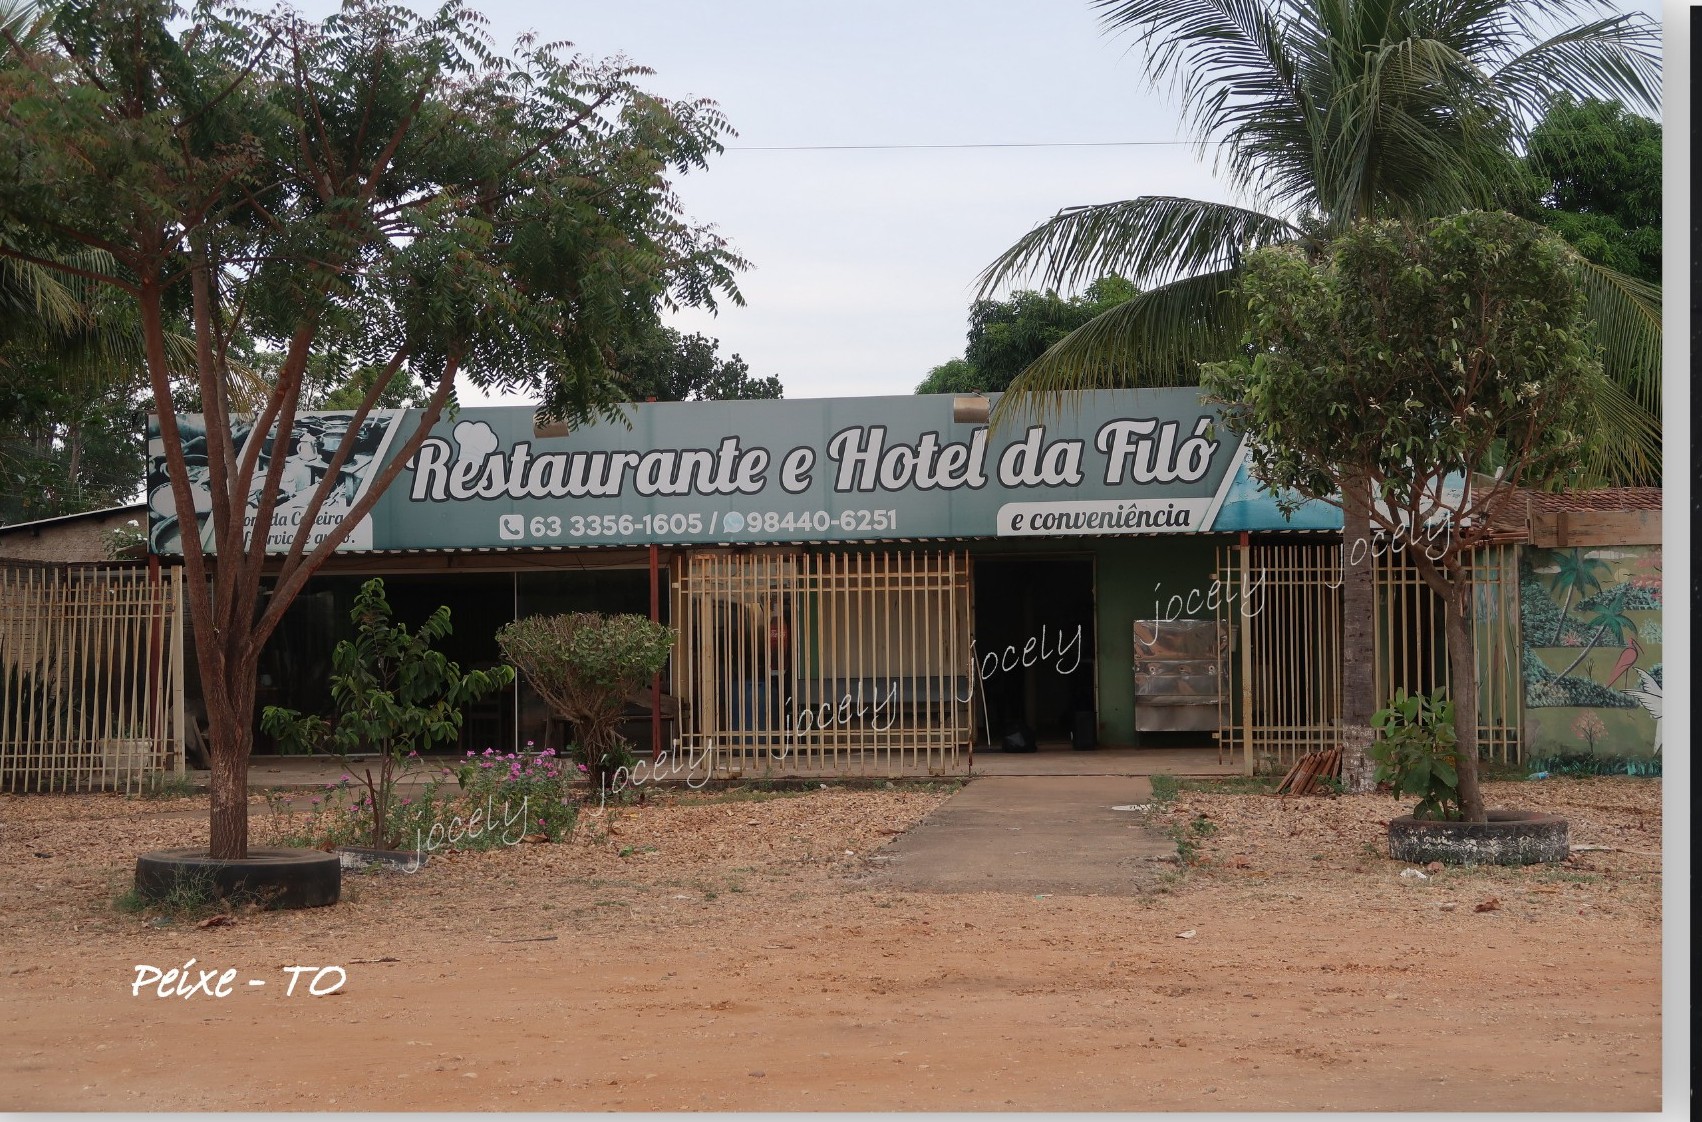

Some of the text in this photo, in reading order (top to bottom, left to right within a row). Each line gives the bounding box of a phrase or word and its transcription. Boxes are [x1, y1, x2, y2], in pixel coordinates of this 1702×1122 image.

[405, 415, 1221, 503] Restaurante e Hotel da Filó
[291, 511, 343, 527] Ceira
[530, 509, 898, 538] 63 3356-1605 / 98440-6251
[1011, 503, 1191, 532] e conveniência
